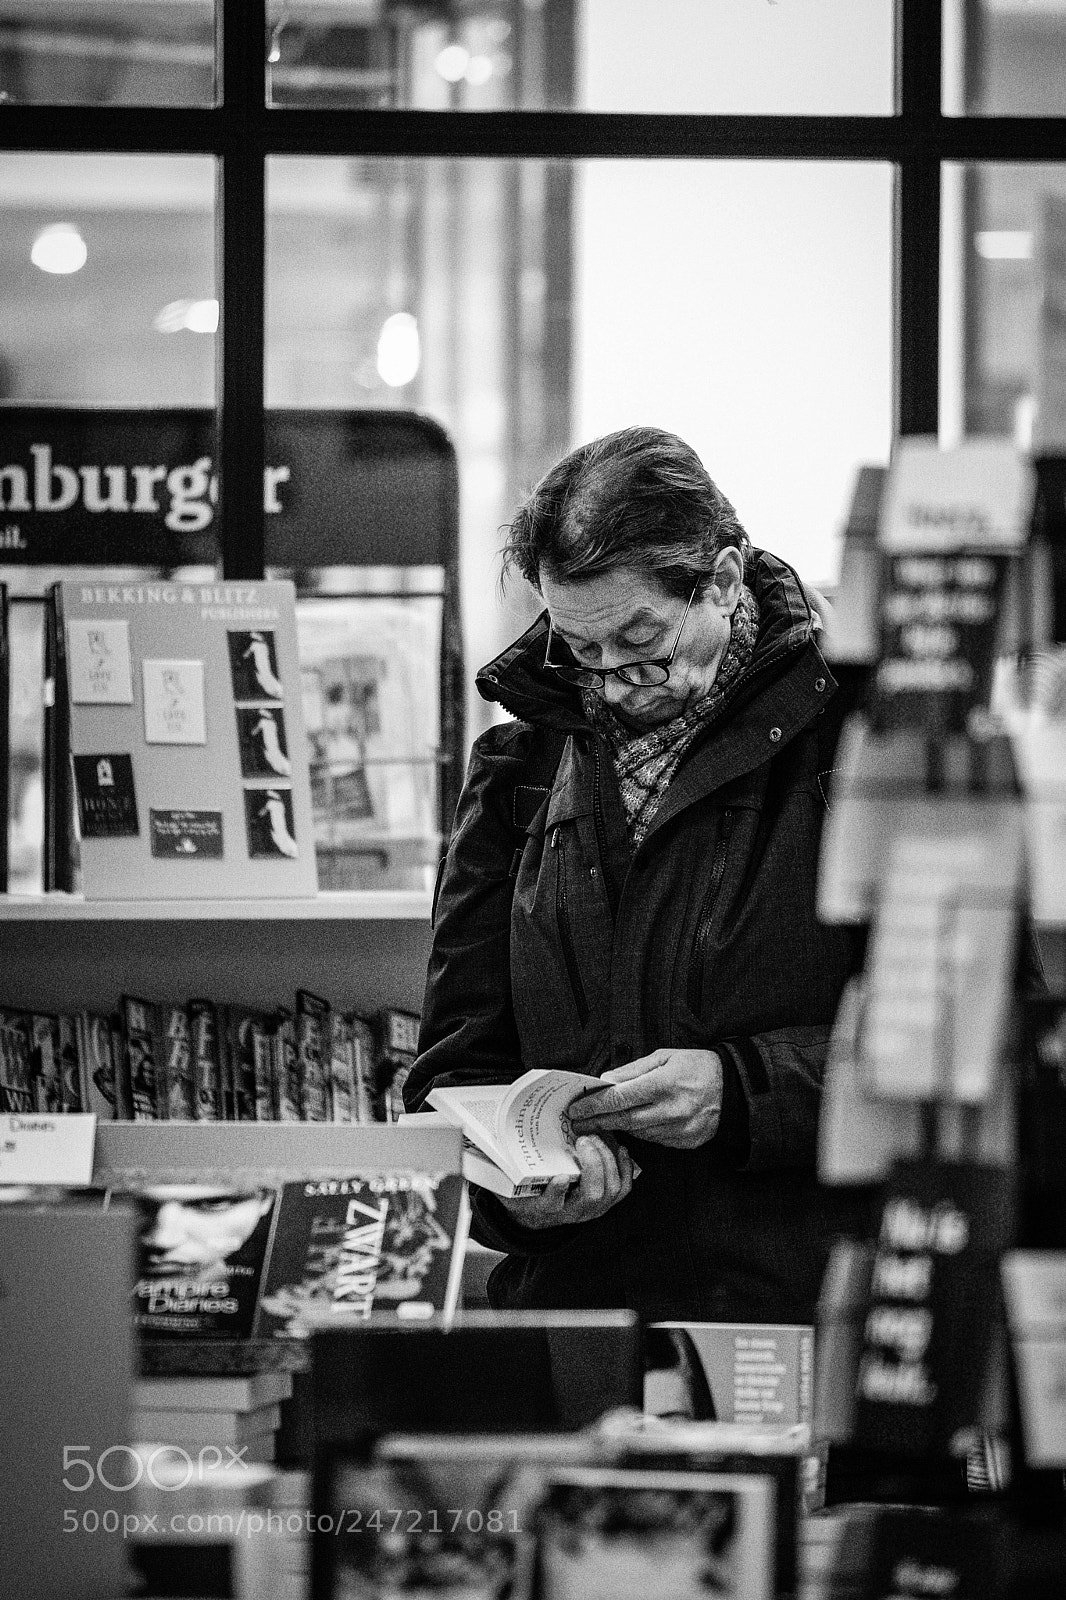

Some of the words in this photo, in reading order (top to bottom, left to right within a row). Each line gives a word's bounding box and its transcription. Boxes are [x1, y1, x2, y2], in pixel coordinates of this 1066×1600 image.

[0, 443, 291, 532] burgr
[80, 587, 178, 604] BEKKING
[182, 587, 195, 604] &
[200, 587, 258, 604] BLITZ
[331, 1199, 389, 1320] ZWART
[131, 1279, 230, 1300] ampire
[148, 1297, 239, 1314] Diaries
